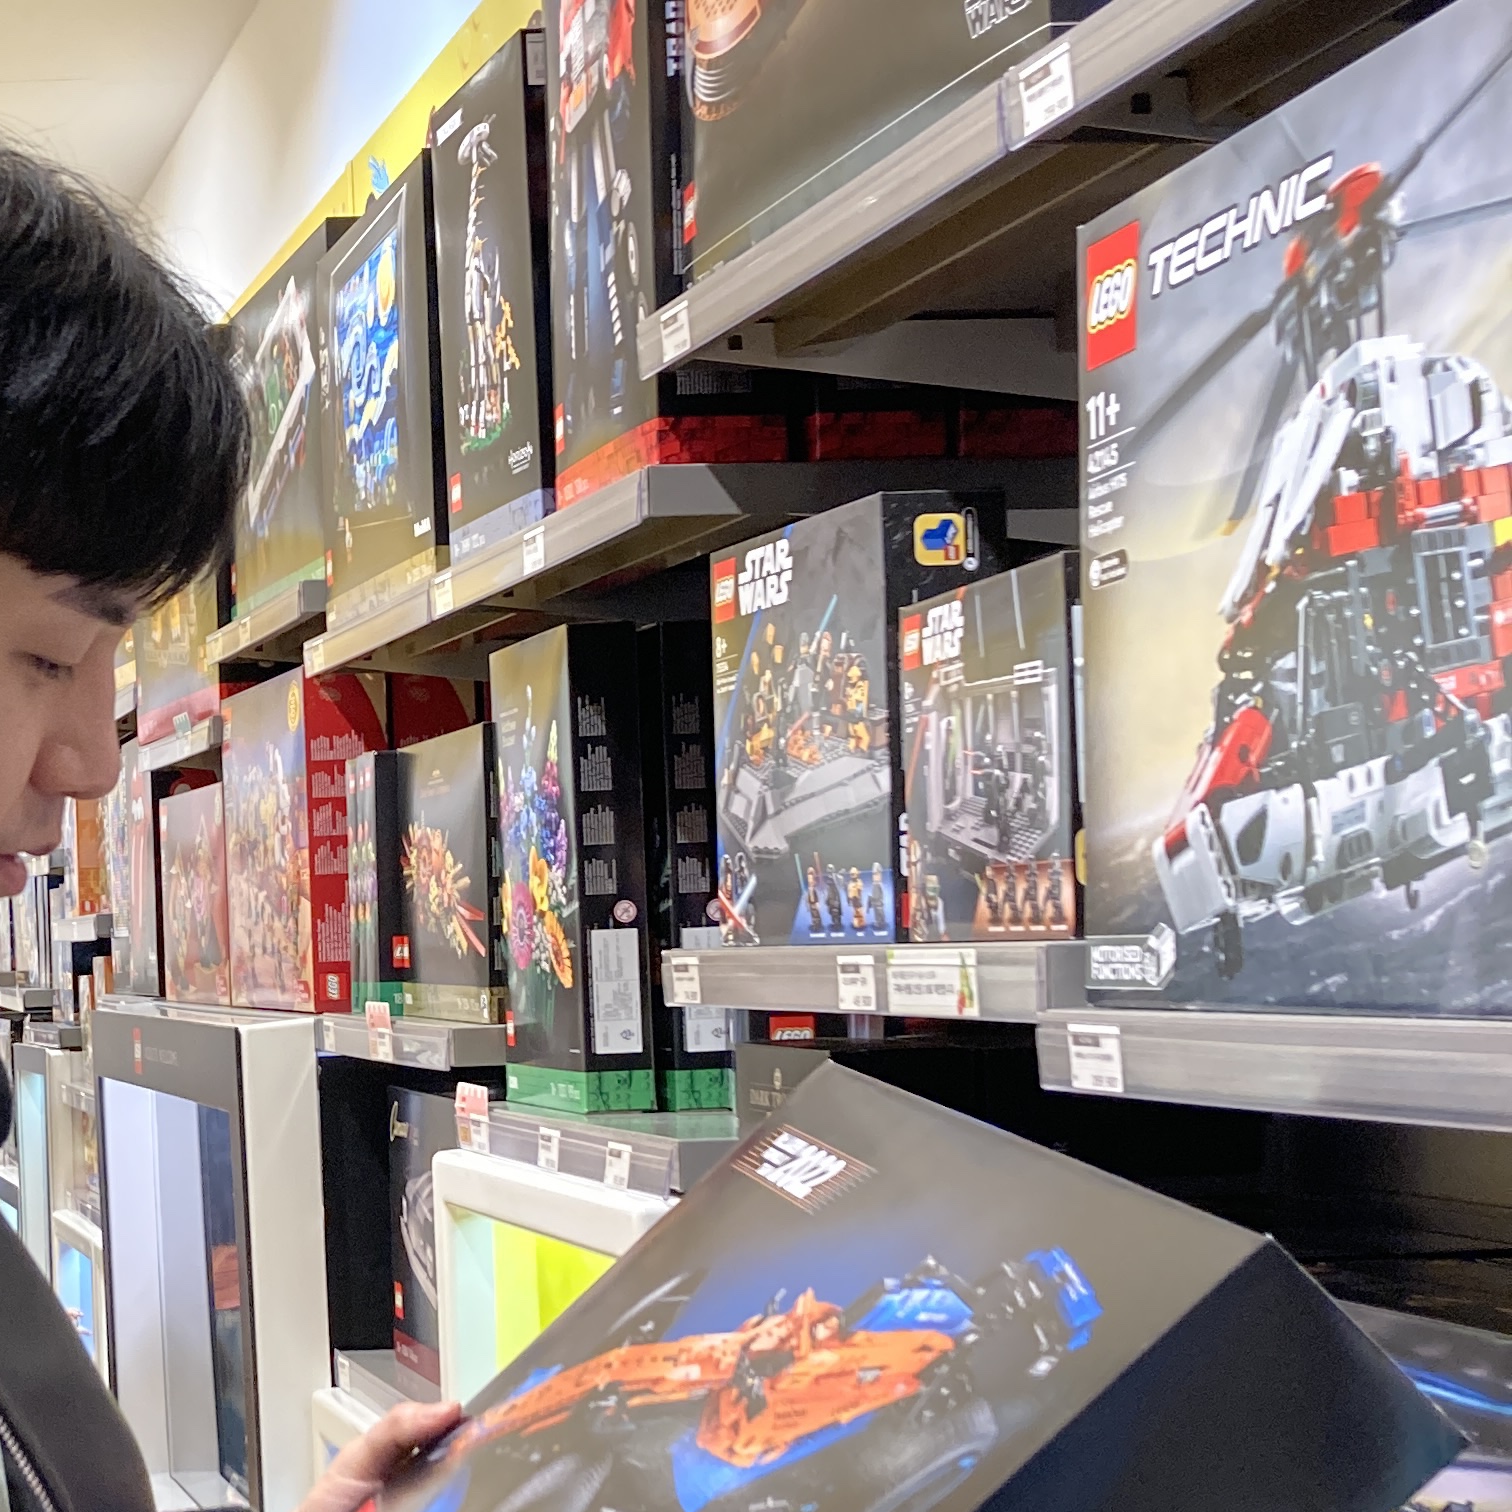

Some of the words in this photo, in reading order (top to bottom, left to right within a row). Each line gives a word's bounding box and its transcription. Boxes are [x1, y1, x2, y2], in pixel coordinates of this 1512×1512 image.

[1149, 154, 1334, 297] TECHNIC
[1089, 260, 1136, 330] LEGO
[1086, 391, 1120, 440] 11+
[738, 538, 793, 585] STAR
[738, 569, 793, 616] WARS
[922, 600, 965, 640] STAR
[922, 627, 965, 665] WARS
[327, 974, 339, 1000] LEGO
